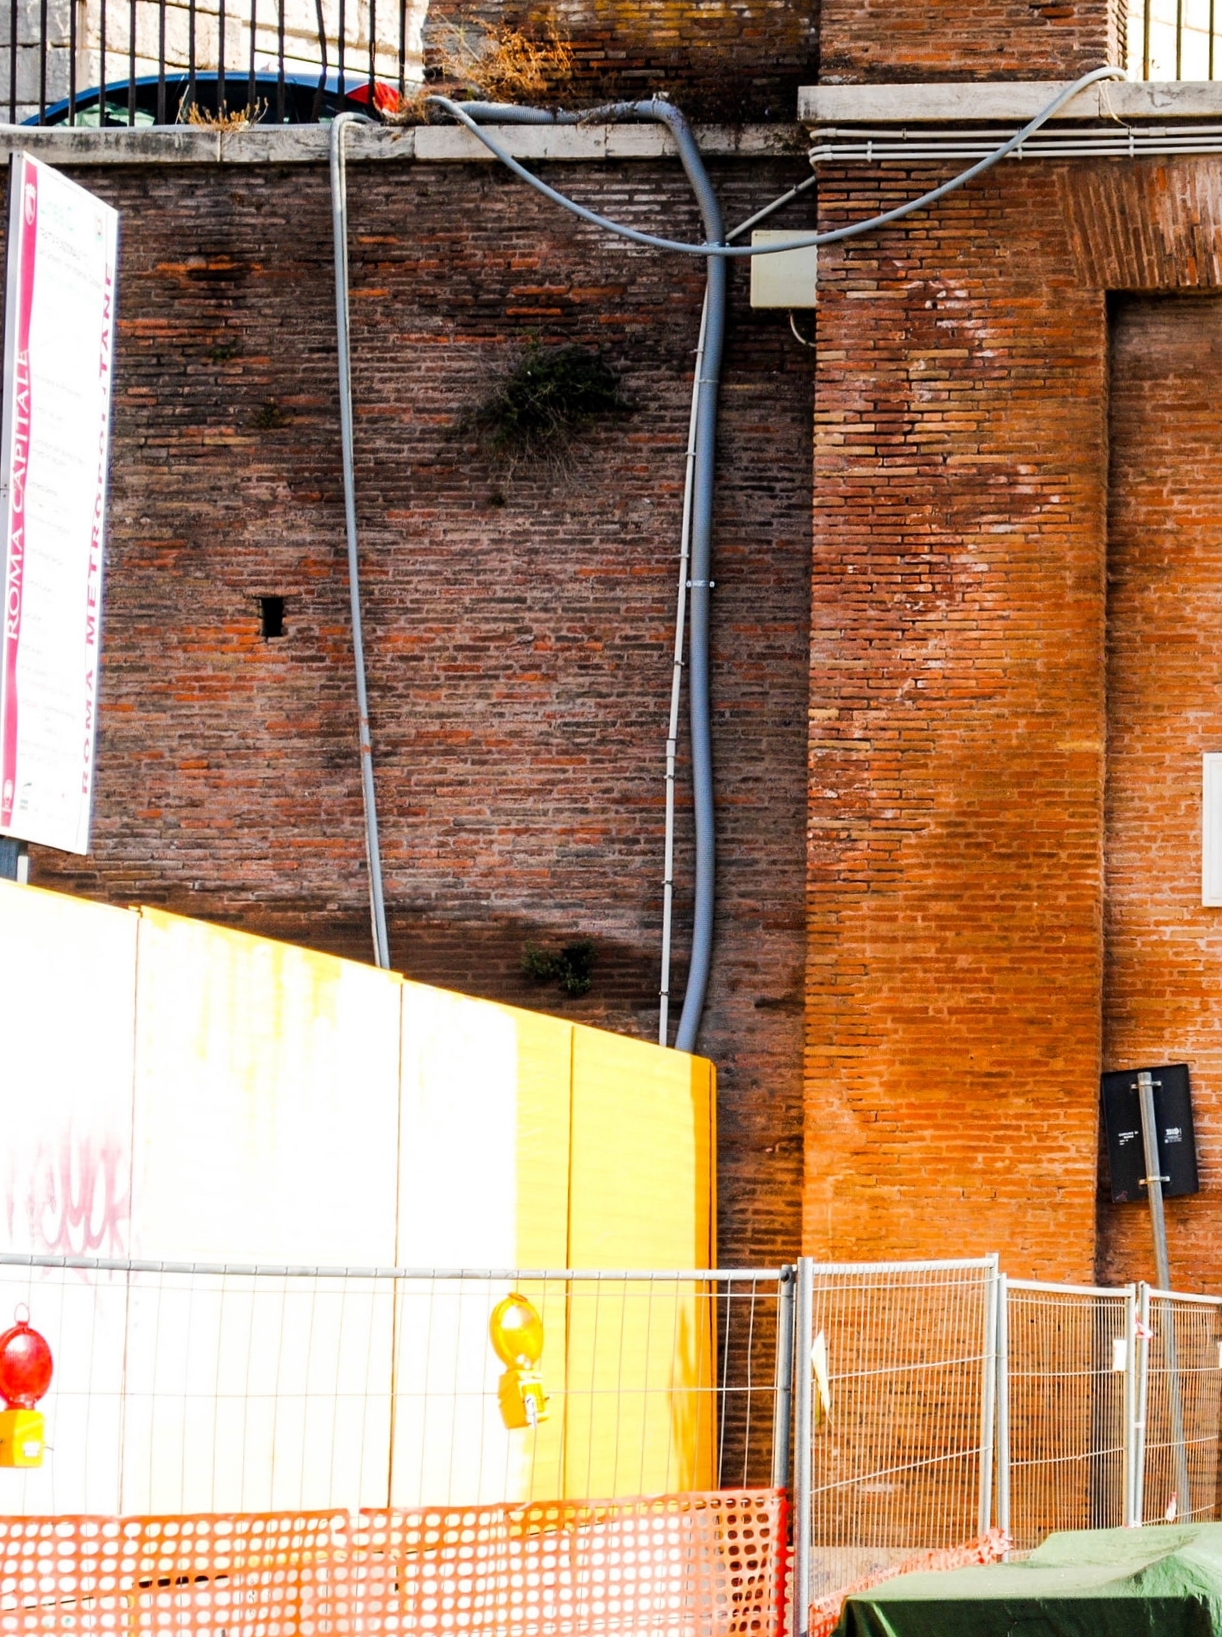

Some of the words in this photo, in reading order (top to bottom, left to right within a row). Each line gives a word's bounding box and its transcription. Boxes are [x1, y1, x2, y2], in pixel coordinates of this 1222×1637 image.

[12, 349, 30, 514] CAPITALE
[6, 526, 25, 641] ROMA
[81, 668, 94, 795] ROMA
